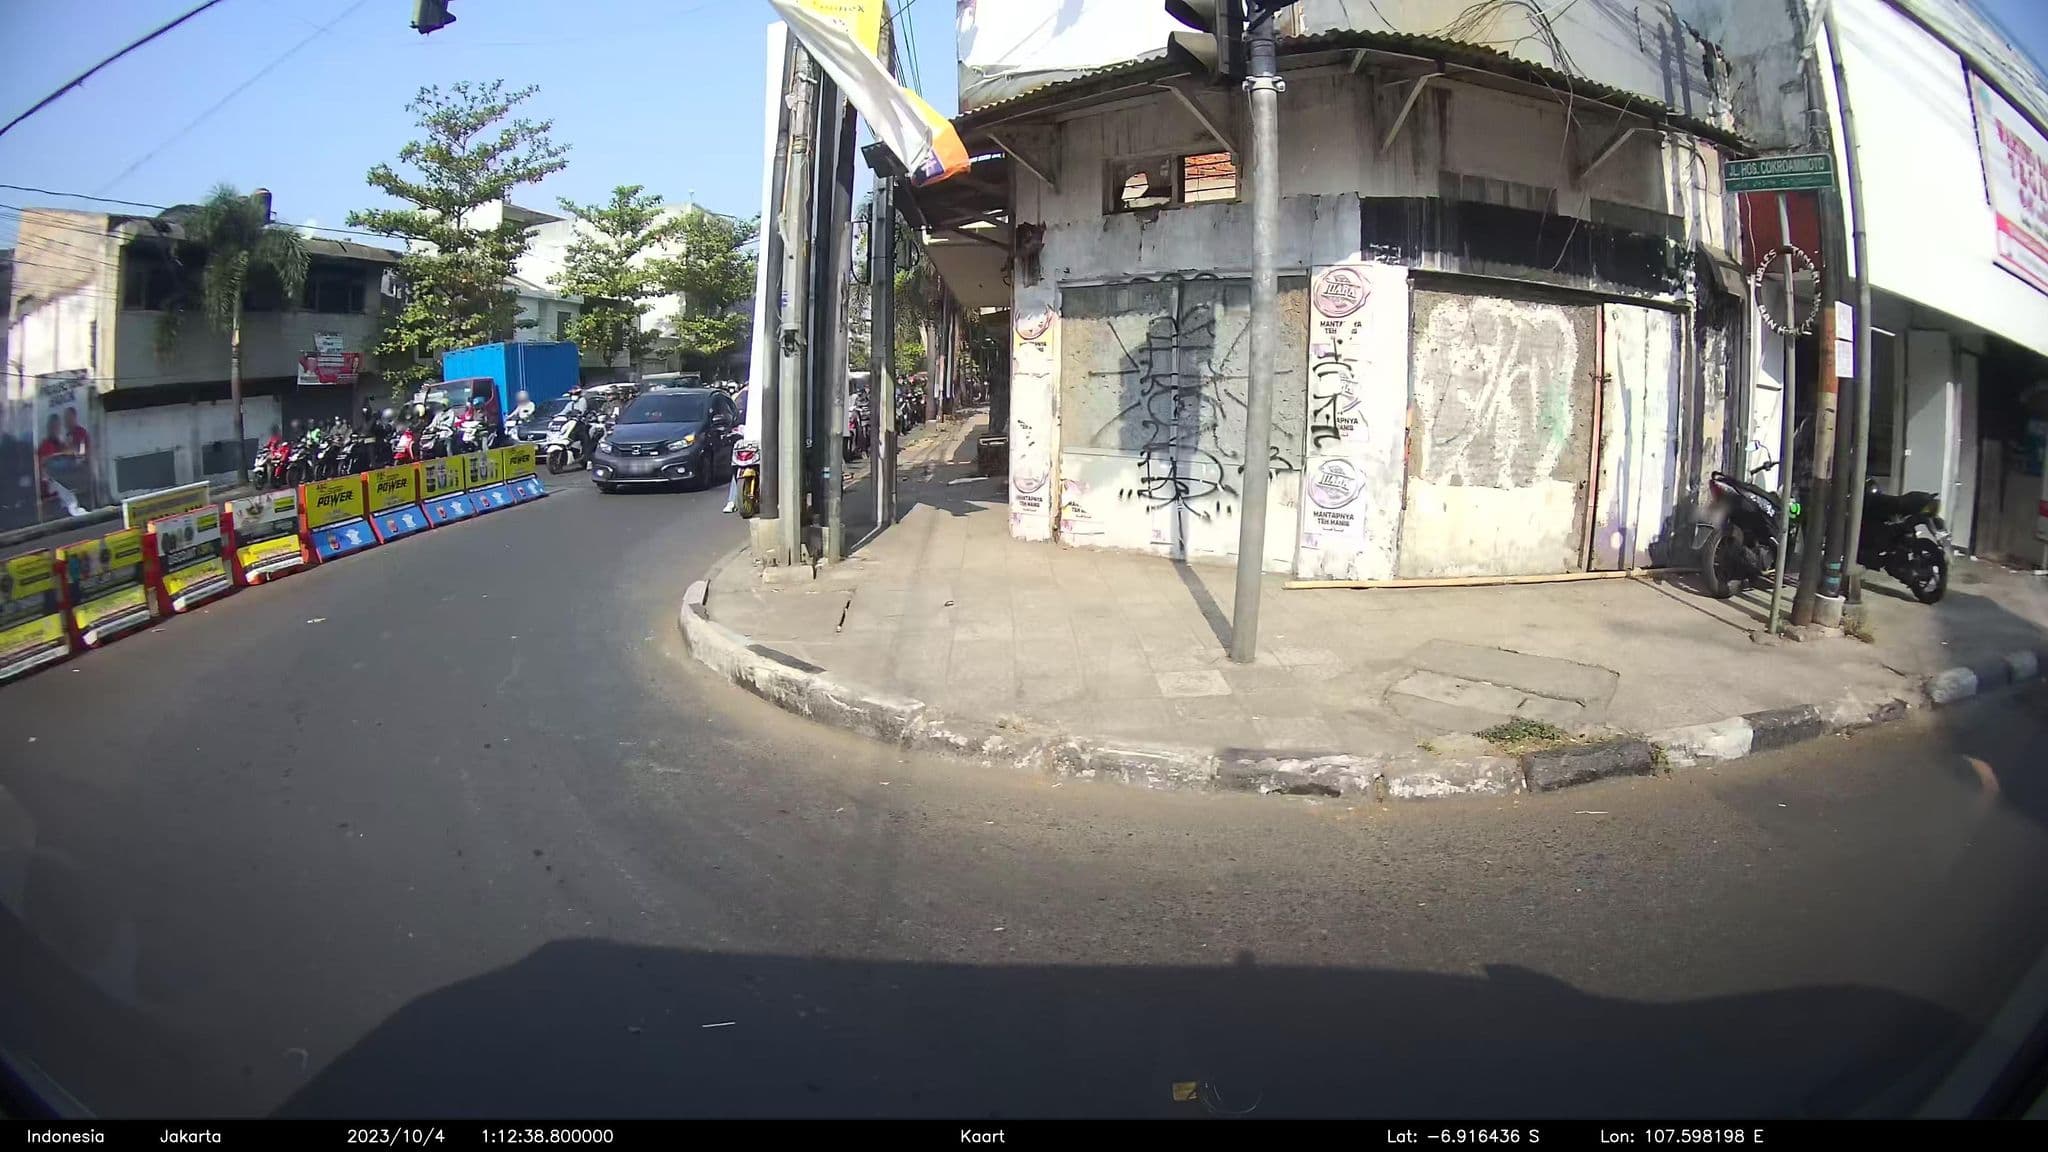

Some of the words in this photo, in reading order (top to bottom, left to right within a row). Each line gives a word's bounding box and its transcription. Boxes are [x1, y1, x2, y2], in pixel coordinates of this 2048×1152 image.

[376, 477, 408, 494] POWER
[316, 490, 354, 508] POWER
[1313, 511, 1355, 520] MANTAPNYA
